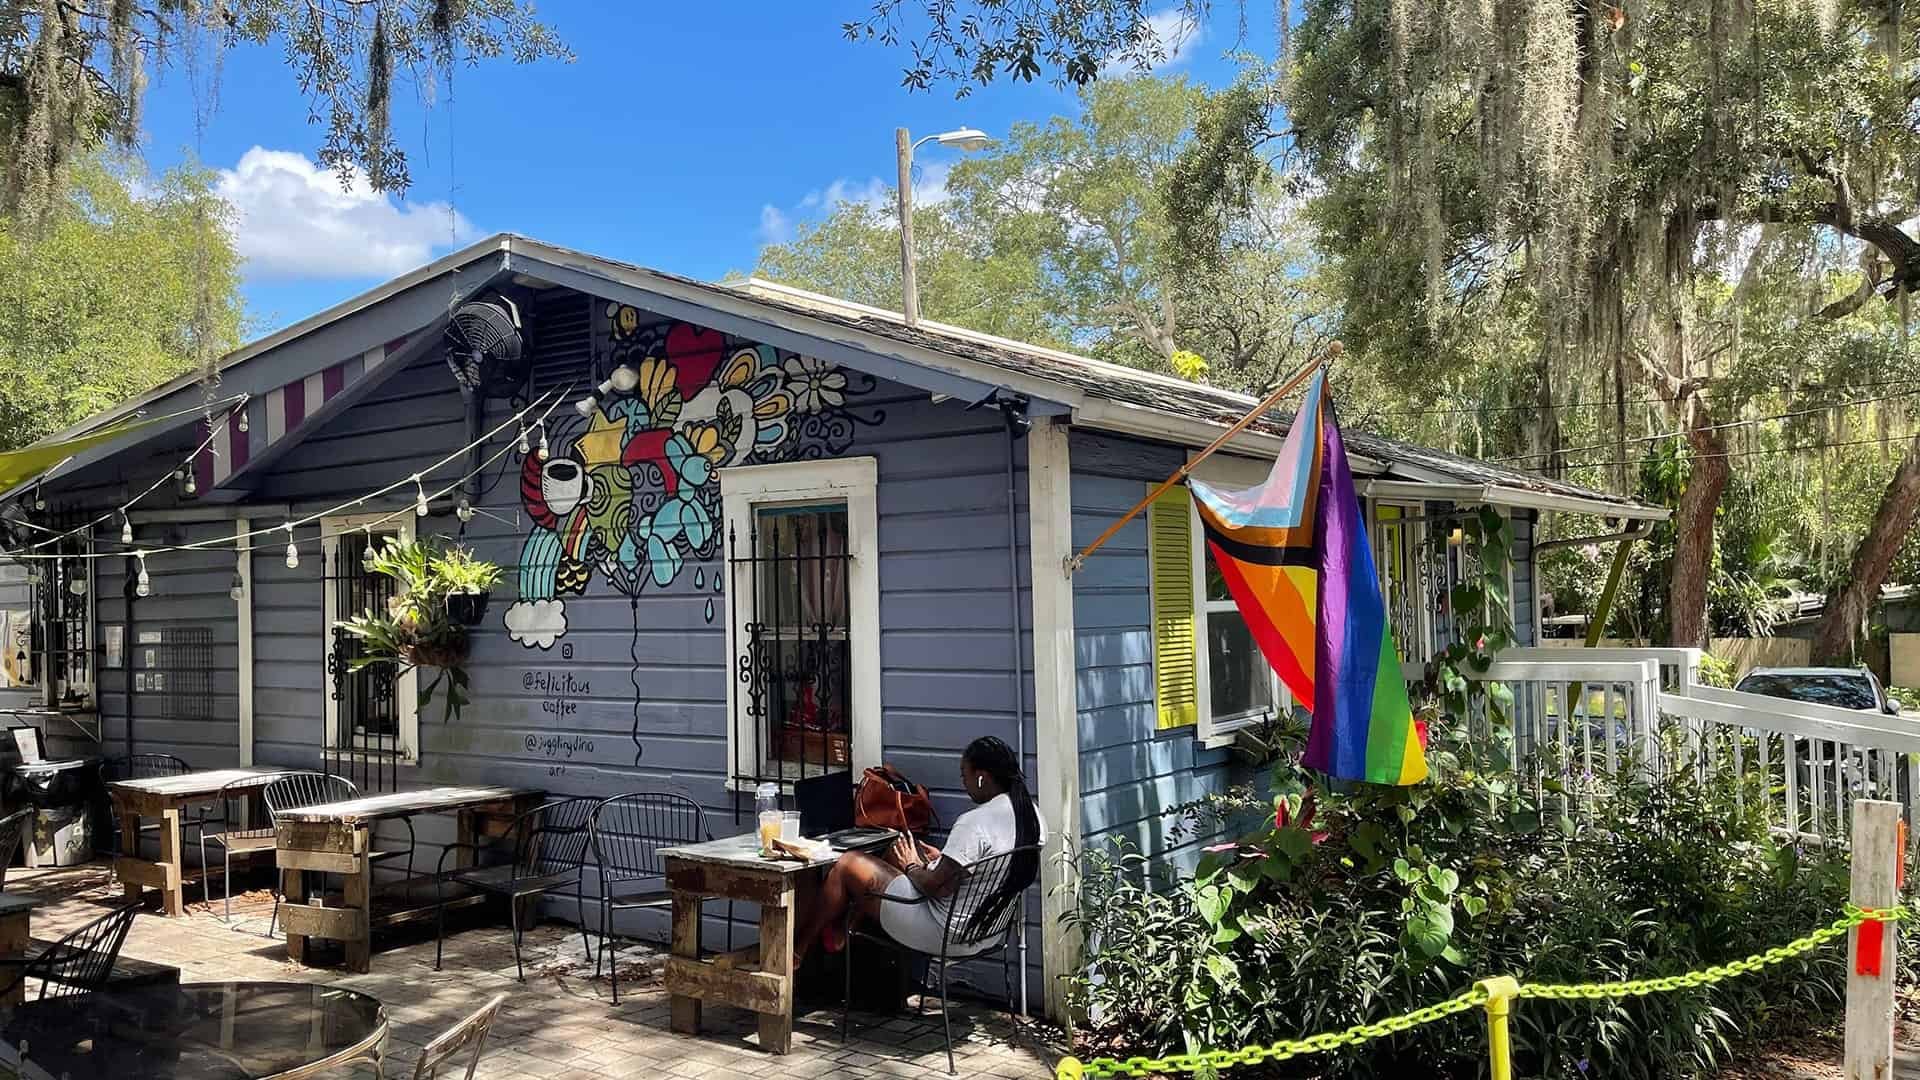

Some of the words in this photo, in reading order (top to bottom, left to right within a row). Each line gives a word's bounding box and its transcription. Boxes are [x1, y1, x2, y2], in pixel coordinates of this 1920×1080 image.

[523, 671, 590, 694] @felicitous
[542, 699, 577, 717] coffee
[548, 763, 566, 776] art
